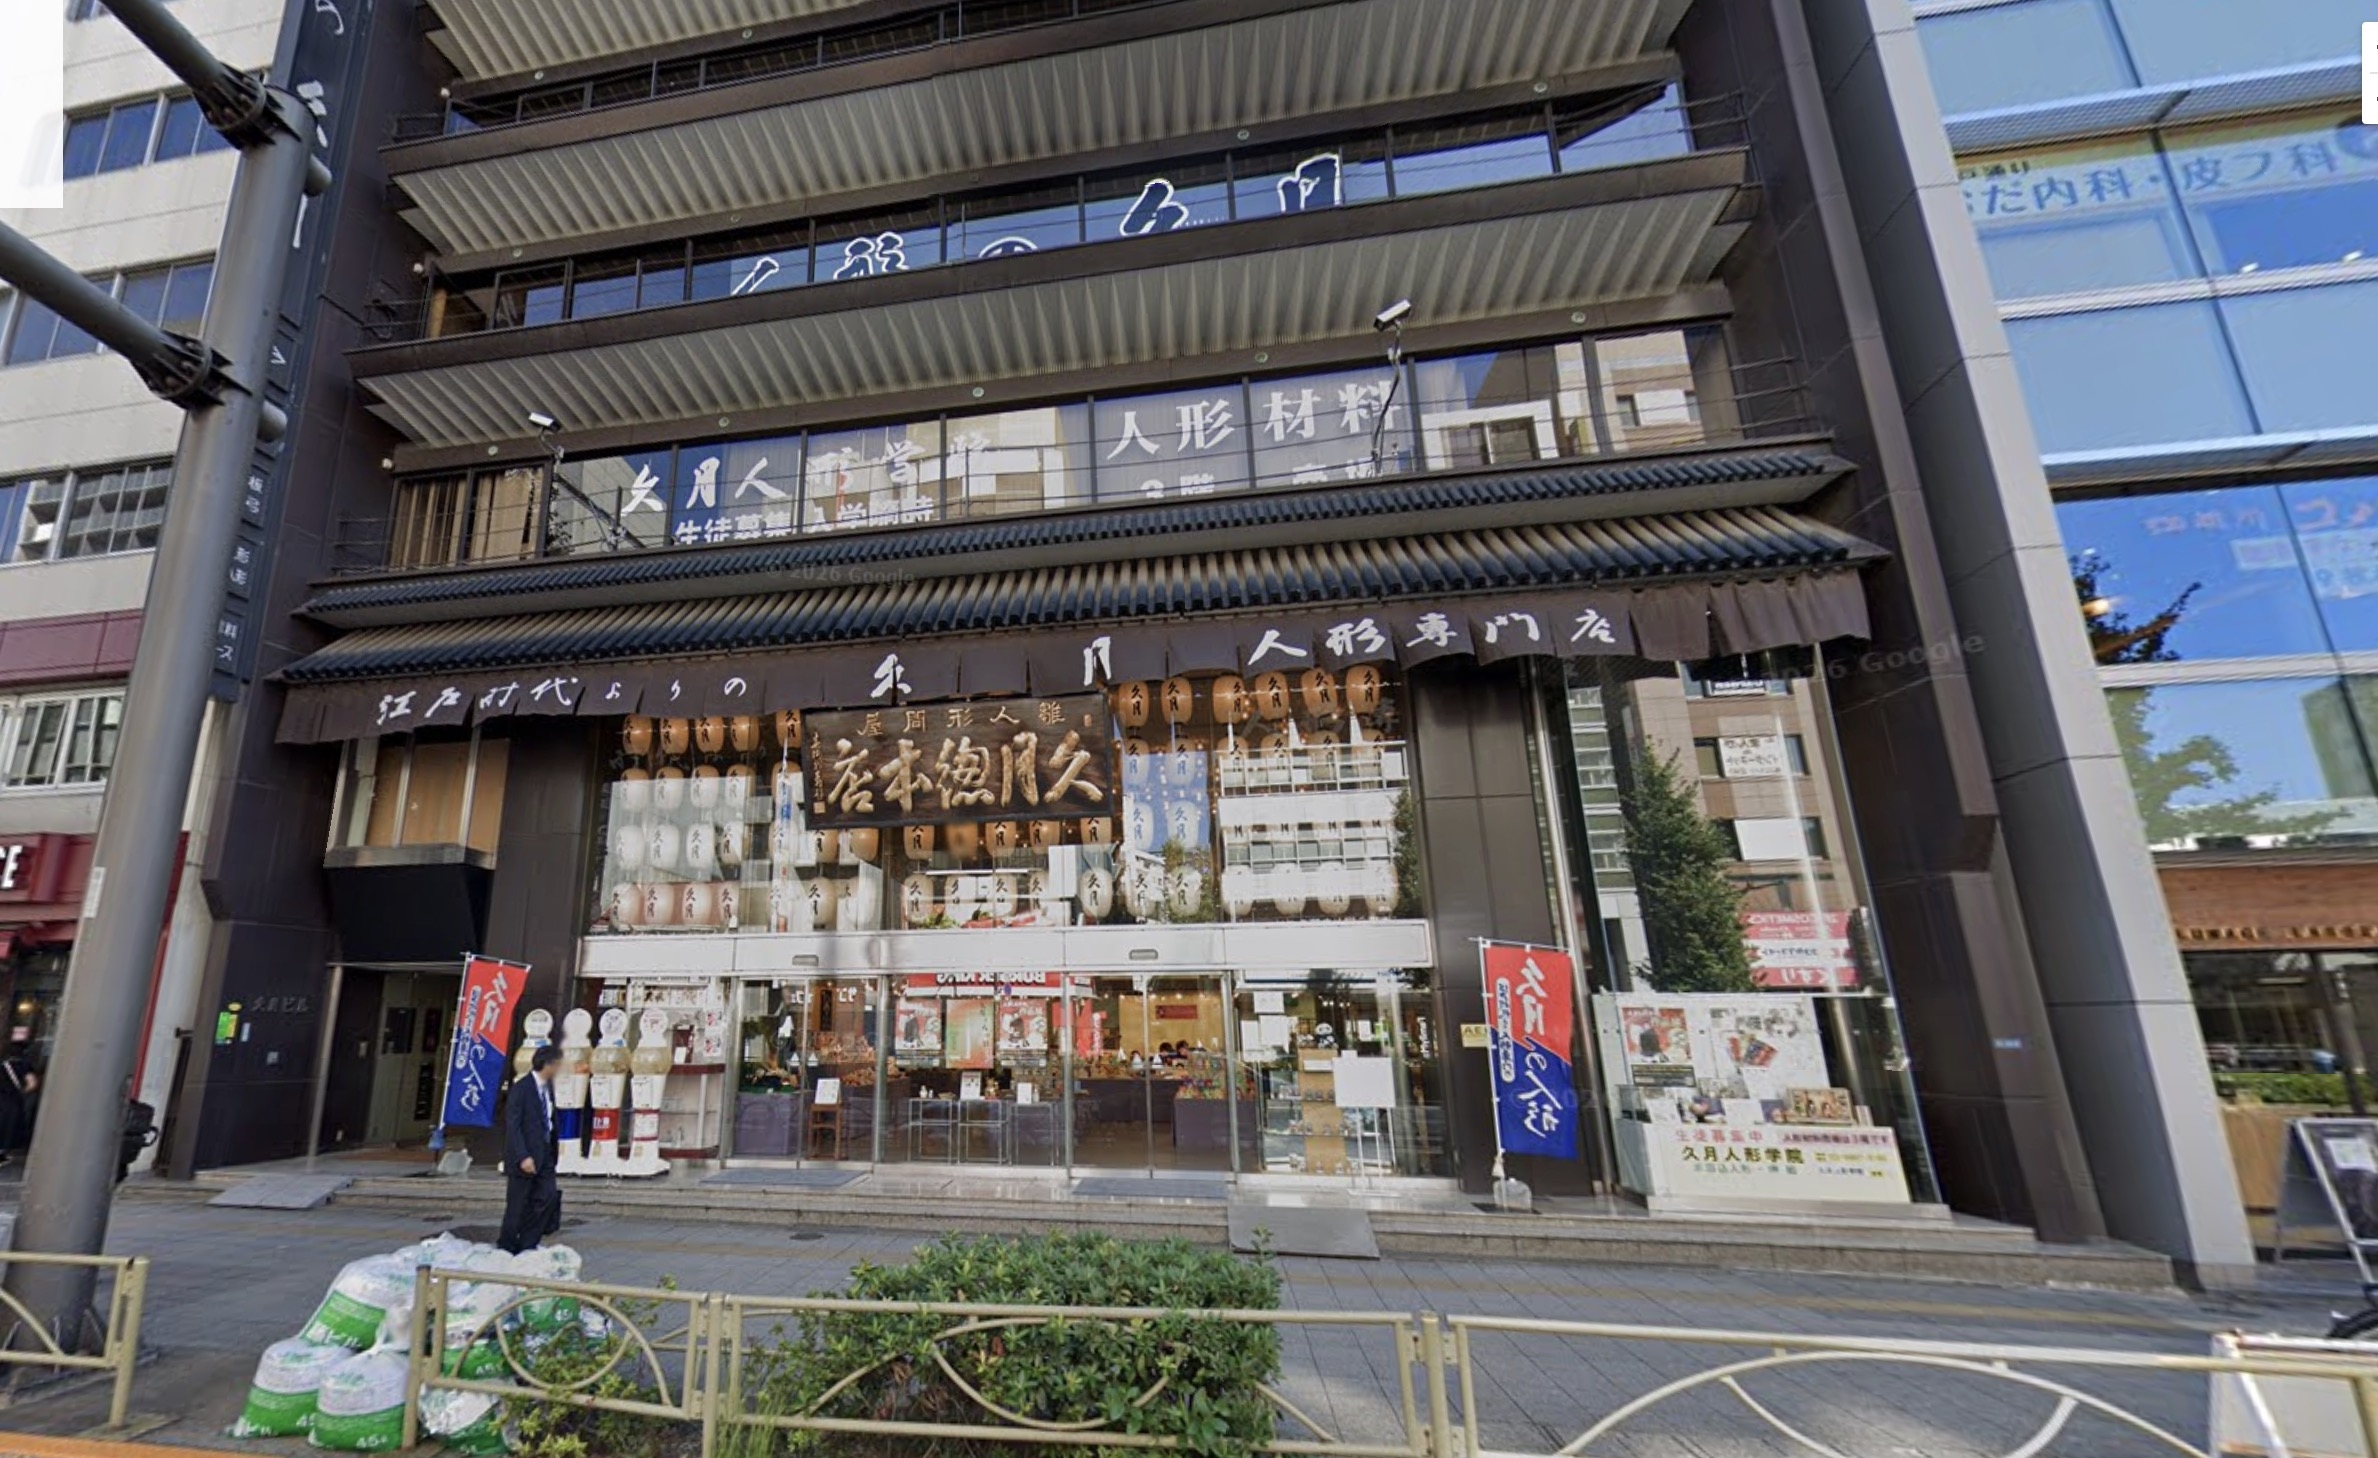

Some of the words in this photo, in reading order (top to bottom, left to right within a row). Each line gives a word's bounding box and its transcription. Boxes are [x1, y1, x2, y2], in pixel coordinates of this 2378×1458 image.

[1961, 139, 2338, 216] だ内科・皮フ科
[1106, 380, 1401, 460] 人形材料
[1131, 684, 1143, 716] 久月
[1168, 681, 1180, 711] 久月
[1233, 681, 1242, 713] 久月
[1268, 676, 1282, 708] 久月
[1315, 672, 1329, 704] 久月
[1362, 669, 1376, 703] 久月
[785, 708, 797, 739] 久月
[1133, 807, 1145, 840] 久月
[1175, 807, 1188, 839] 久月
[646, 882, 659, 915] 久月
[685, 887, 697, 919] 久月
[1088, 872, 1101, 906] 久月
[1682, 1145, 1805, 1164] 久月人形学院
